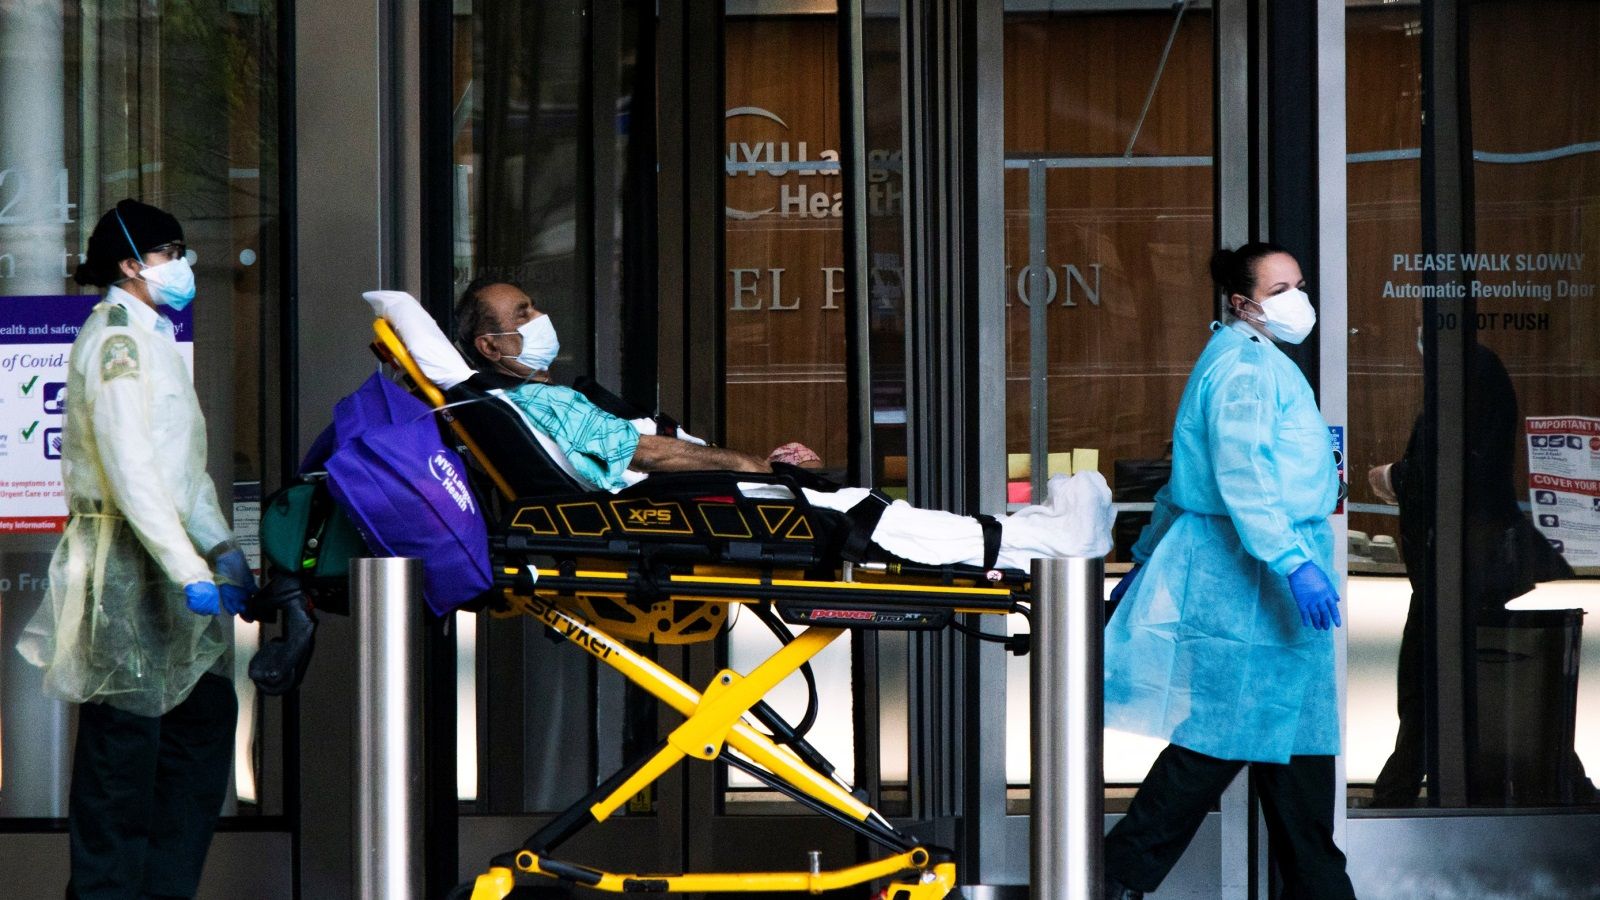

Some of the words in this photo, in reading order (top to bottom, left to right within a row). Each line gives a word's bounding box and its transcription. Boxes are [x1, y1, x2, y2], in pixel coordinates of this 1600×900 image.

[1392, 253, 1456, 271] PLEASE
[1460, 253, 1511, 271] WALK
[1515, 253, 1585, 271] SLOWLY
[1382, 280, 1466, 298] Automatic
[1471, 280, 1552, 301] Revolving
[1557, 281, 1595, 297] Door
[28, 324, 49, 335] and
[50, 323, 81, 337] safety
[1503, 313, 1549, 330] PUSH
[2, 354, 17, 372] of
[20, 354, 70, 368] Covid-
[1530, 420, 1592, 431] IMPORTANT
[434, 454, 455, 477] NYU
[1533, 474, 1573, 488] COVER
[1574, 481, 1598, 491] YOUR
[442, 477, 468, 512] Health
[628, 508, 672, 522] XPS
[524, 600, 614, 659] stryker
